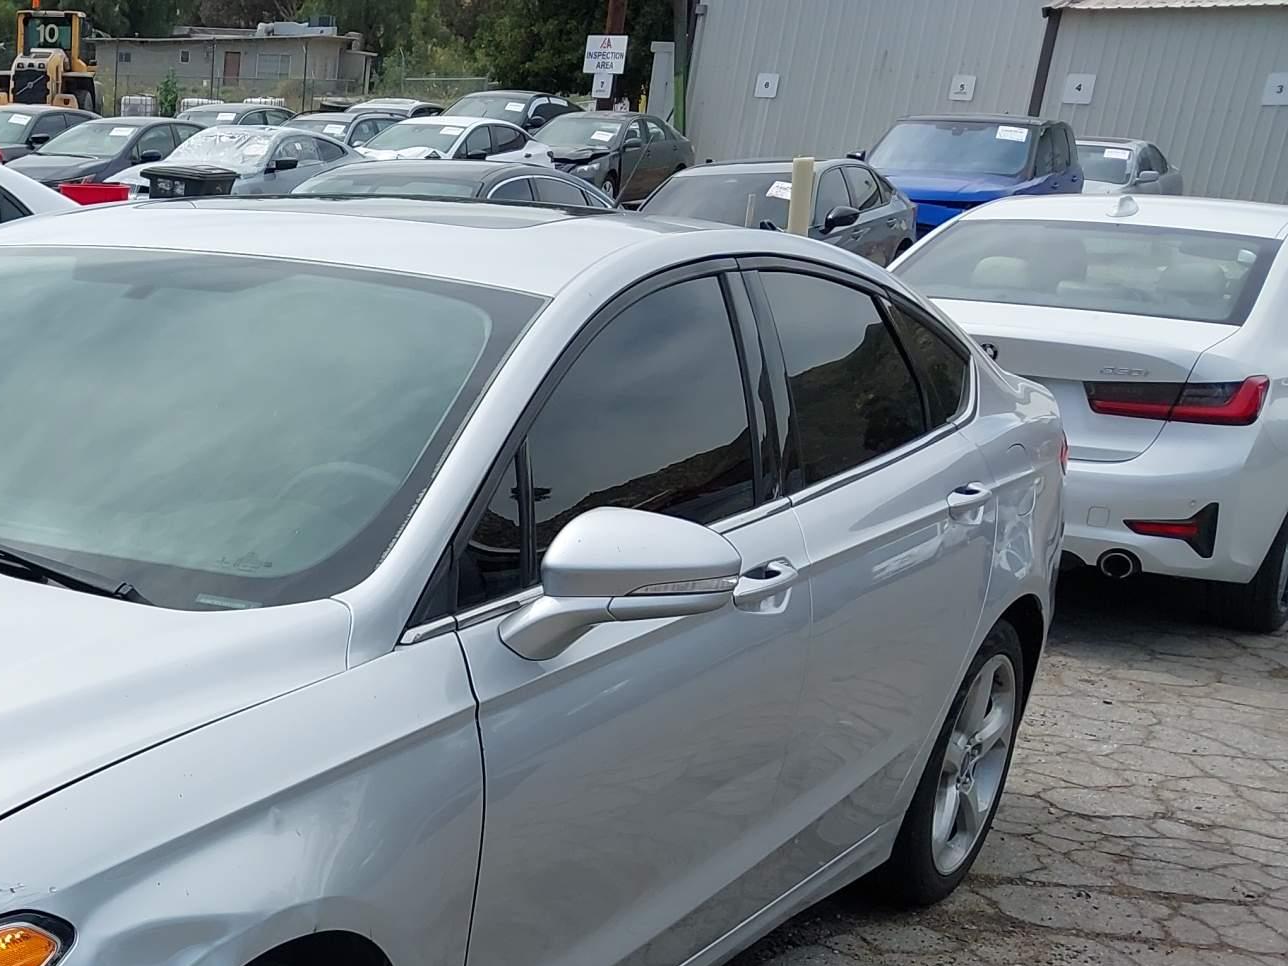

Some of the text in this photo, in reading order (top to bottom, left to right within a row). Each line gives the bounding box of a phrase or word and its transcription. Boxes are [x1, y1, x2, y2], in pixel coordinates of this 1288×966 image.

[36, 24, 59, 45] 10
[587, 52, 624, 60] INSPECTION
[596, 61, 614, 70] AREA
[1075, 83, 1082, 92] 4
[1276, 84, 1284, 94] 3
